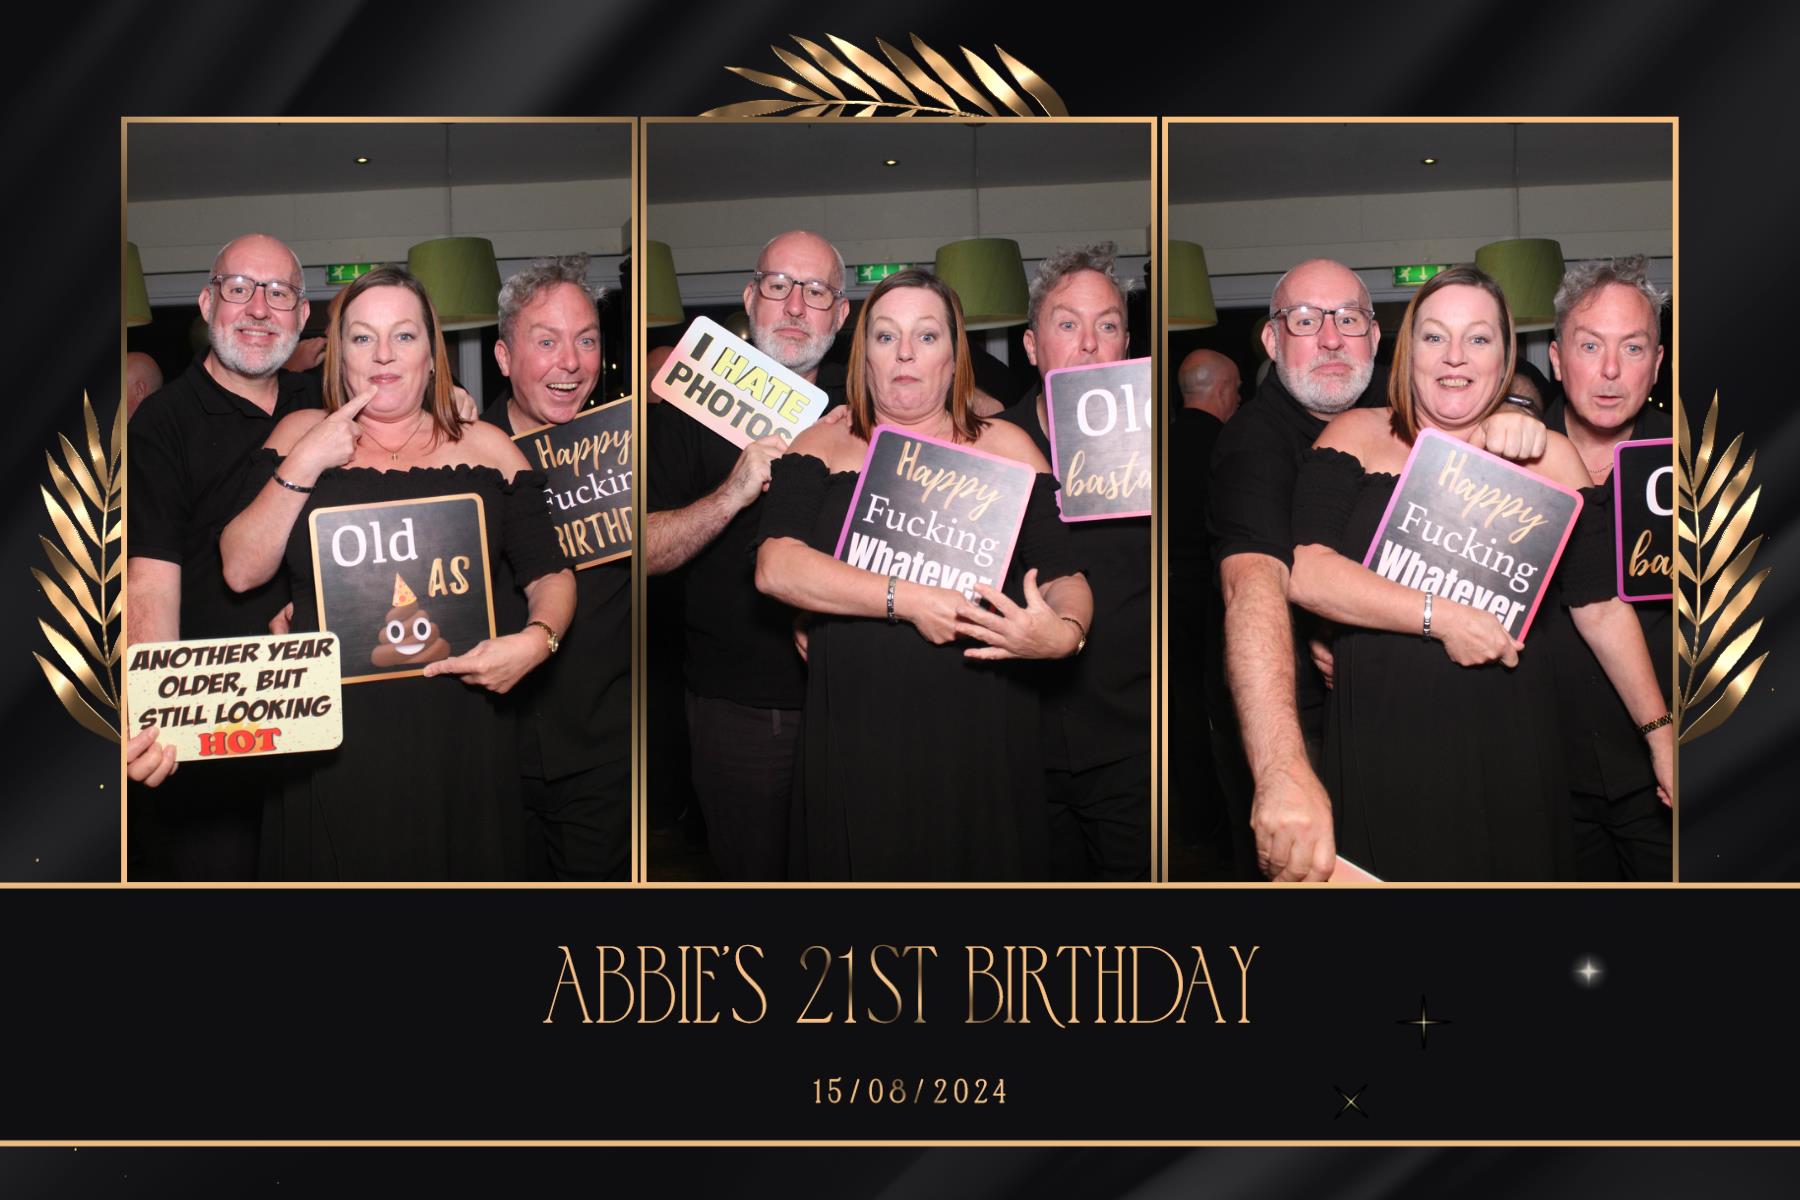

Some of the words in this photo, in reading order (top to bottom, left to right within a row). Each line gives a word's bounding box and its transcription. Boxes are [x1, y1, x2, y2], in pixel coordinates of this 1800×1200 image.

[690, 333, 714, 361] I
[711, 347, 811, 424] HATE
[1077, 384, 1152, 437] Ol
[534, 430, 632, 477] Happy
[896, 441, 1005, 521] Happy
[1439, 449, 1549, 544] Happy
[331, 517, 418, 567] Old
[862, 493, 1000, 568] Fucking
[1397, 501, 1538, 594] Fucking
[1629, 529, 1673, 580] ba
[428, 555, 470, 597] AS
[1376, 539, 1525, 631] Whatever
[129, 642, 260, 671] ANOTHER
[267, 637, 334, 661] YEAR
[158, 672, 247, 698] OLDER,
[256, 667, 308, 691] BUT
[138, 704, 208, 730] STILL
[215, 695, 332, 724] LOOKING
[198, 727, 281, 756] HOT
